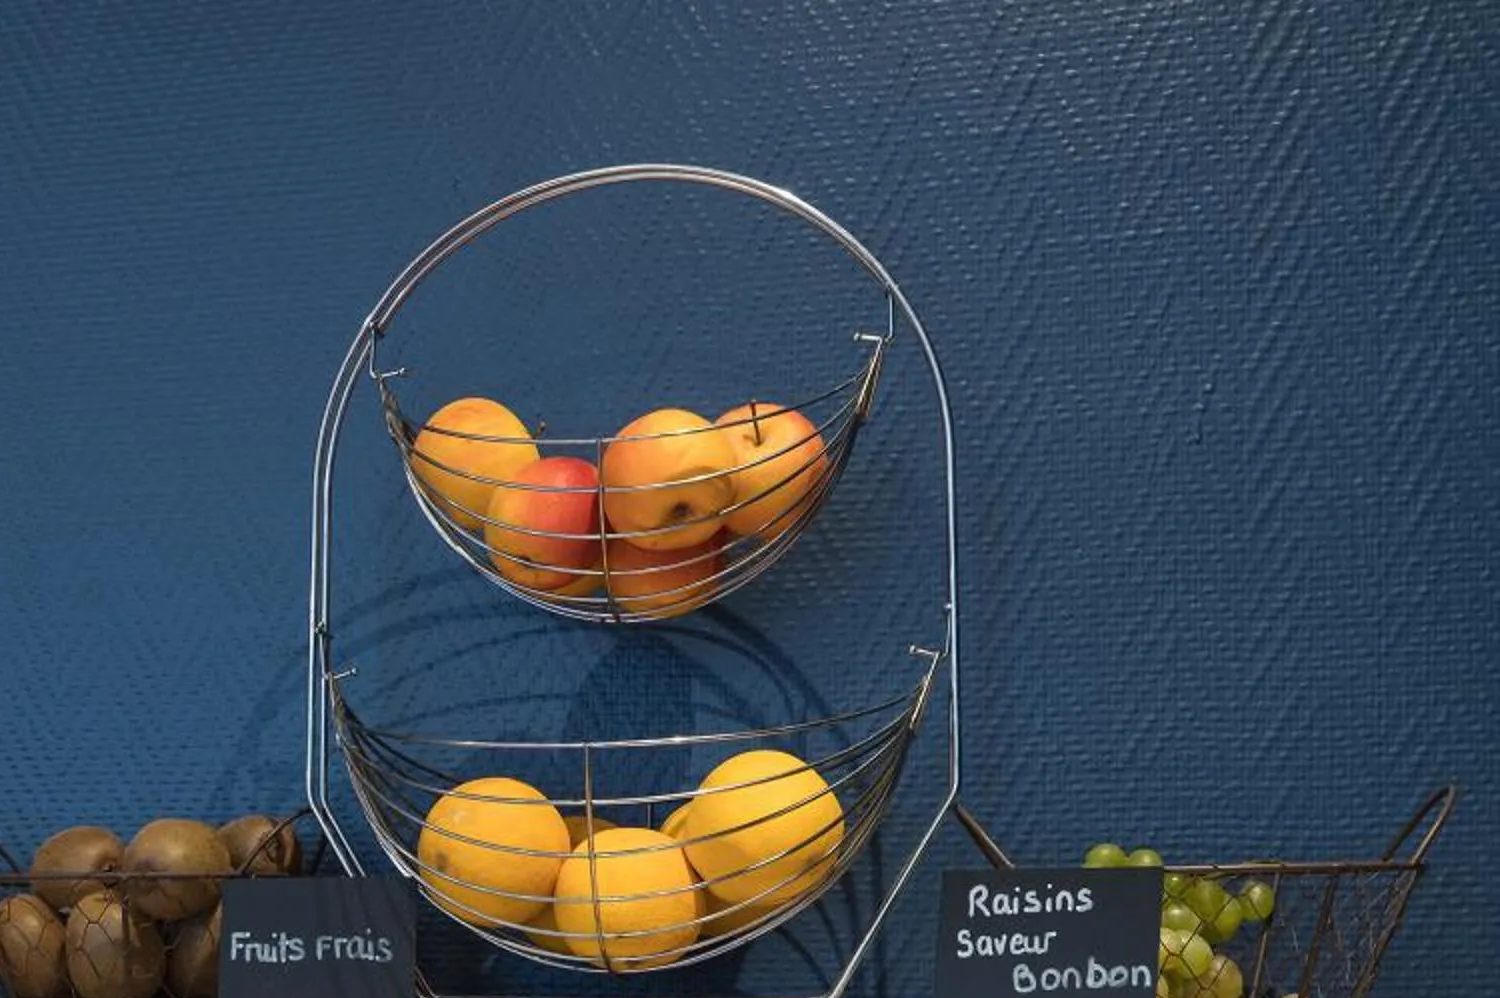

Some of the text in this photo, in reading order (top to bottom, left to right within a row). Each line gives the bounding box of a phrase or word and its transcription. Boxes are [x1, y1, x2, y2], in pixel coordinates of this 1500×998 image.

[968, 883, 1094, 918] Raisins
[230, 927, 394, 963] Fruits Frais
[956, 929, 1057, 958] Saveur
